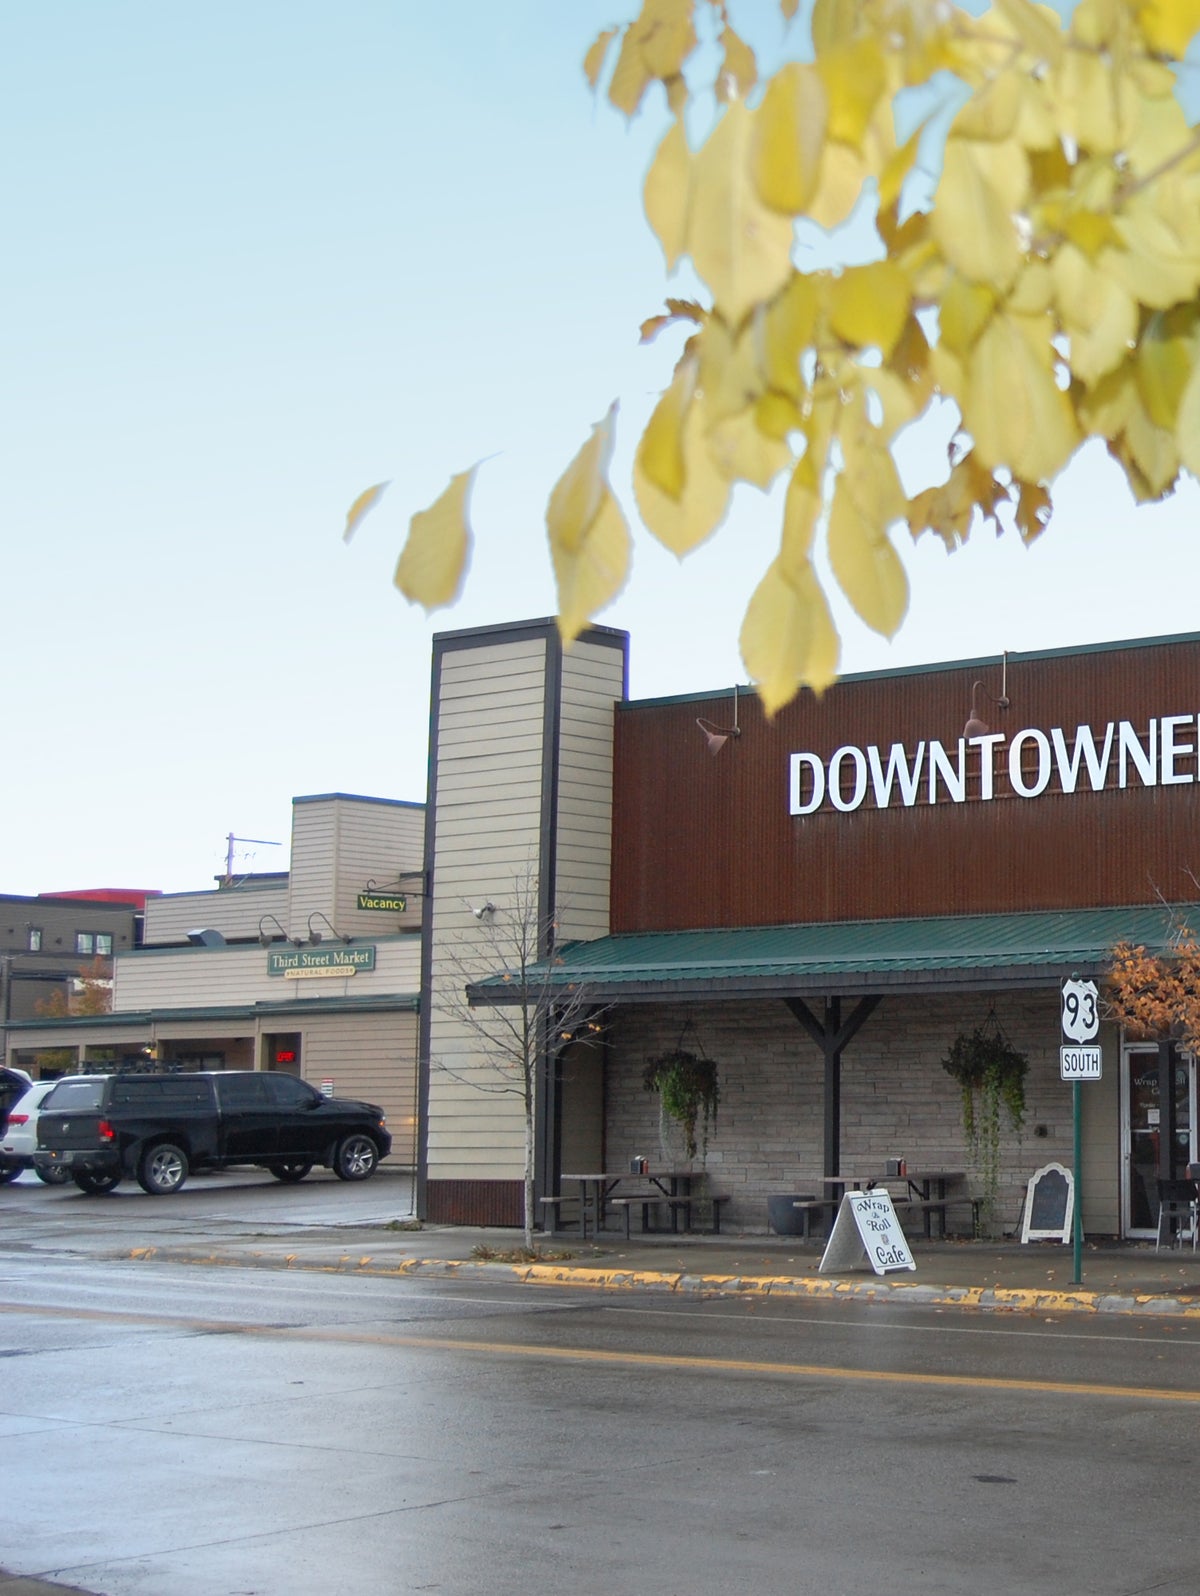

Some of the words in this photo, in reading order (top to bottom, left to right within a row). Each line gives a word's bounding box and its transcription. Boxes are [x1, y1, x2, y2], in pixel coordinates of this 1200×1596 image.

[360, 896, 406, 911] Vacancy
[273, 955, 298, 968] Third
[302, 953, 330, 967] Street
[333, 951, 369, 965] Market
[1066, 992, 1095, 1029] 93
[1064, 1053, 1099, 1072] SOUTH
[857, 1198, 890, 1214] Wrap
[866, 1217, 892, 1232] Roll
[876, 1244, 906, 1265] Cafe
